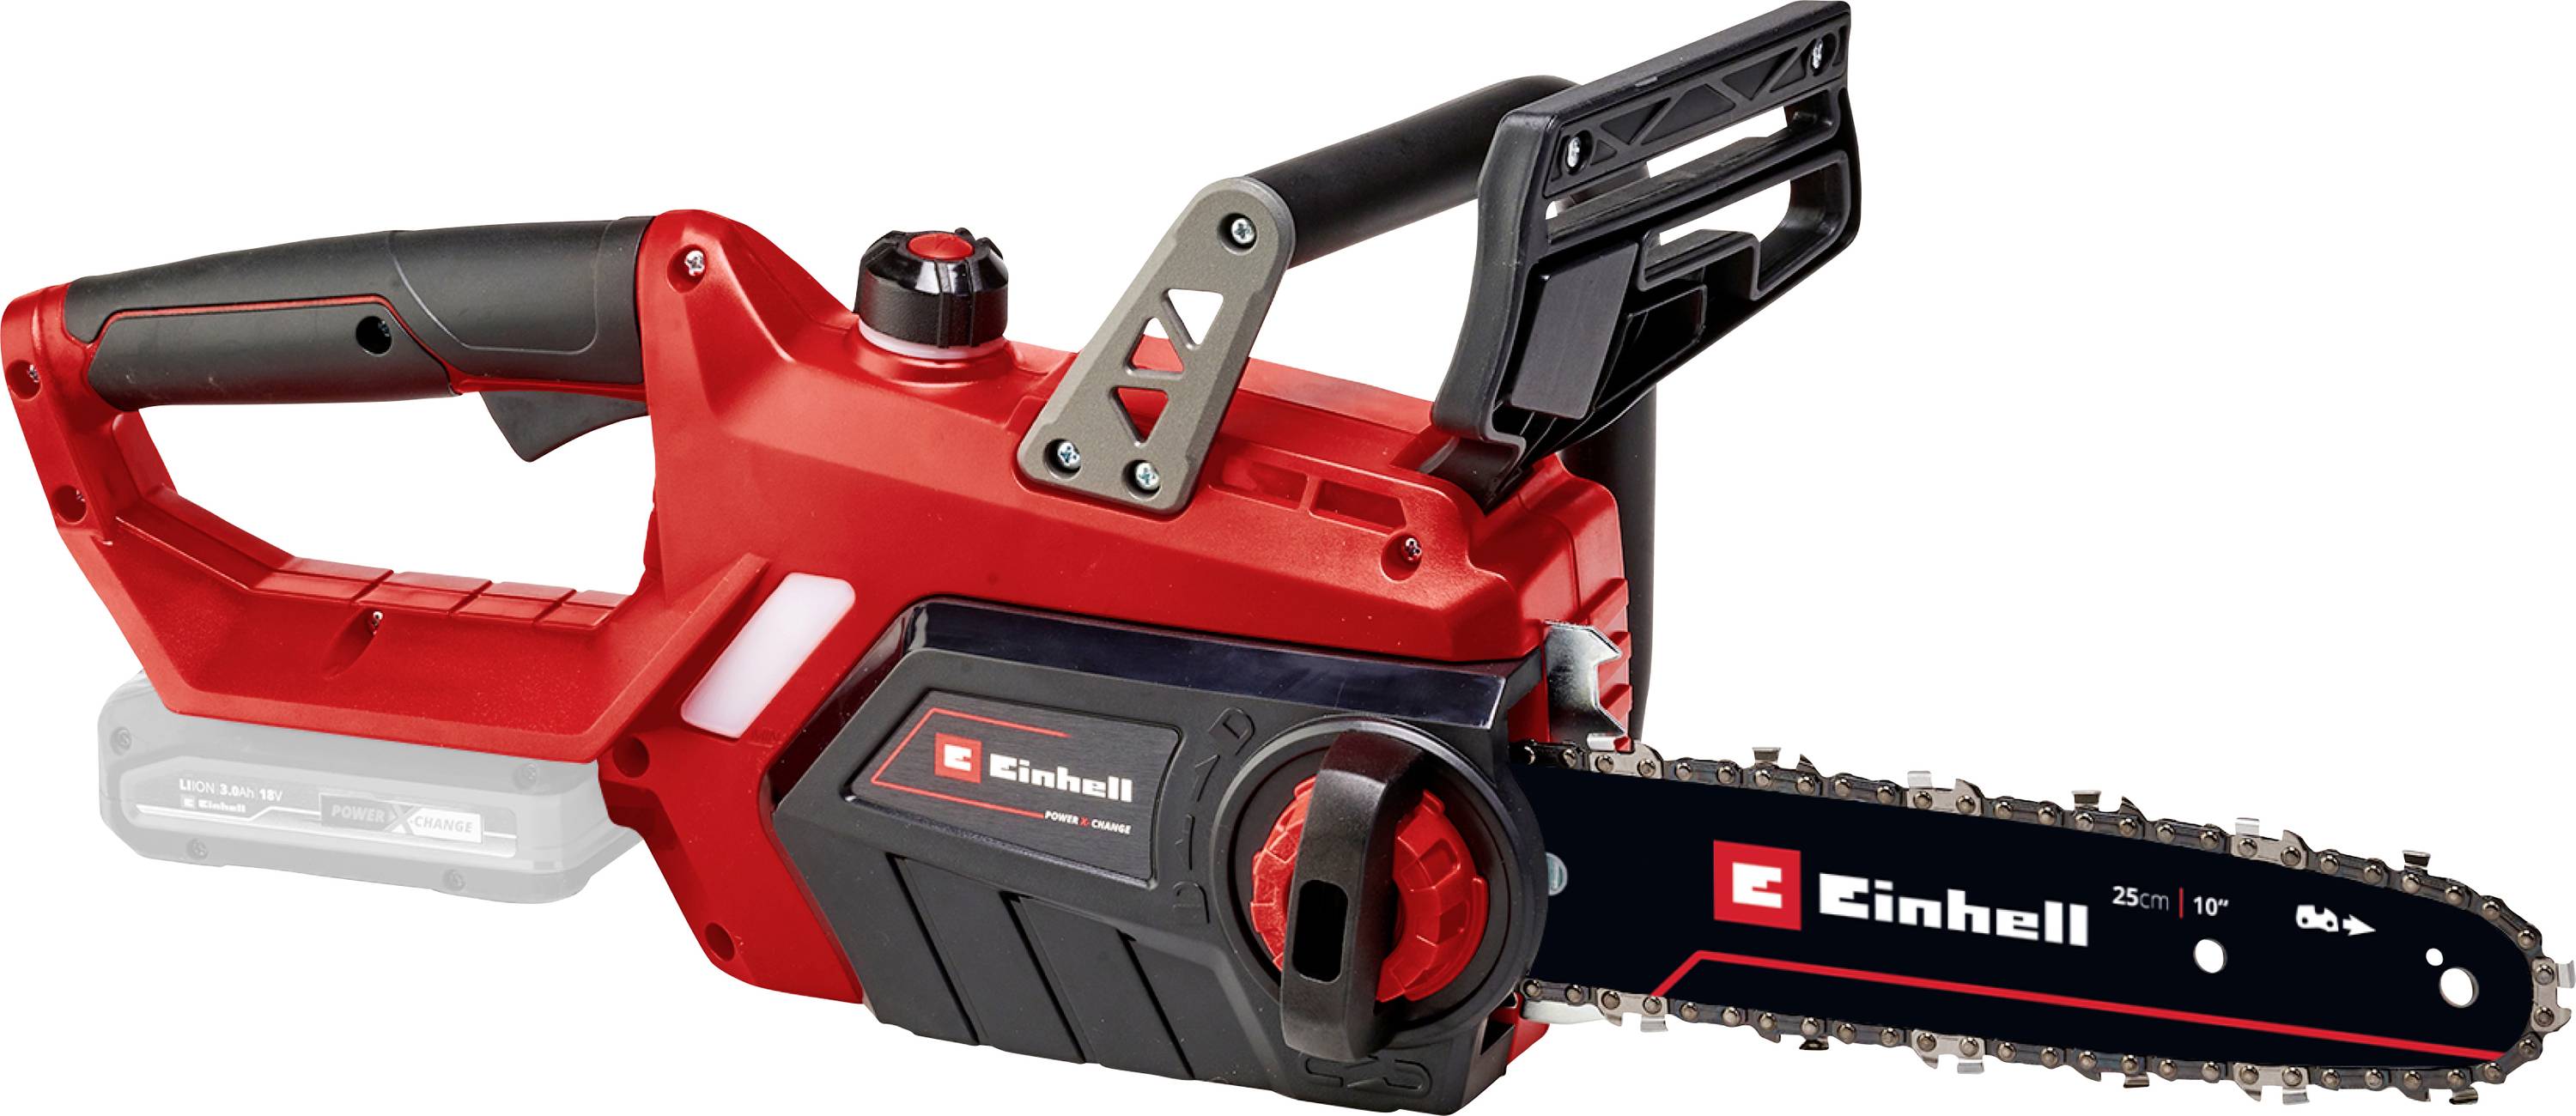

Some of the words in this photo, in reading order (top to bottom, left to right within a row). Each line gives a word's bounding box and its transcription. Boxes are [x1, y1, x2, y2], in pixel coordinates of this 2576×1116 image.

[989, 753, 1133, 803] Einhell
[220, 783, 254, 799] 3.0Ah
[259, 788, 283, 802] 18V
[198, 799, 246, 813] Einhell
[331, 804, 386, 822] POWER
[1044, 810, 1079, 825] POWER
[2111, 886, 2169, 912] 25cm
[1819, 872, 2088, 947] Einhell
